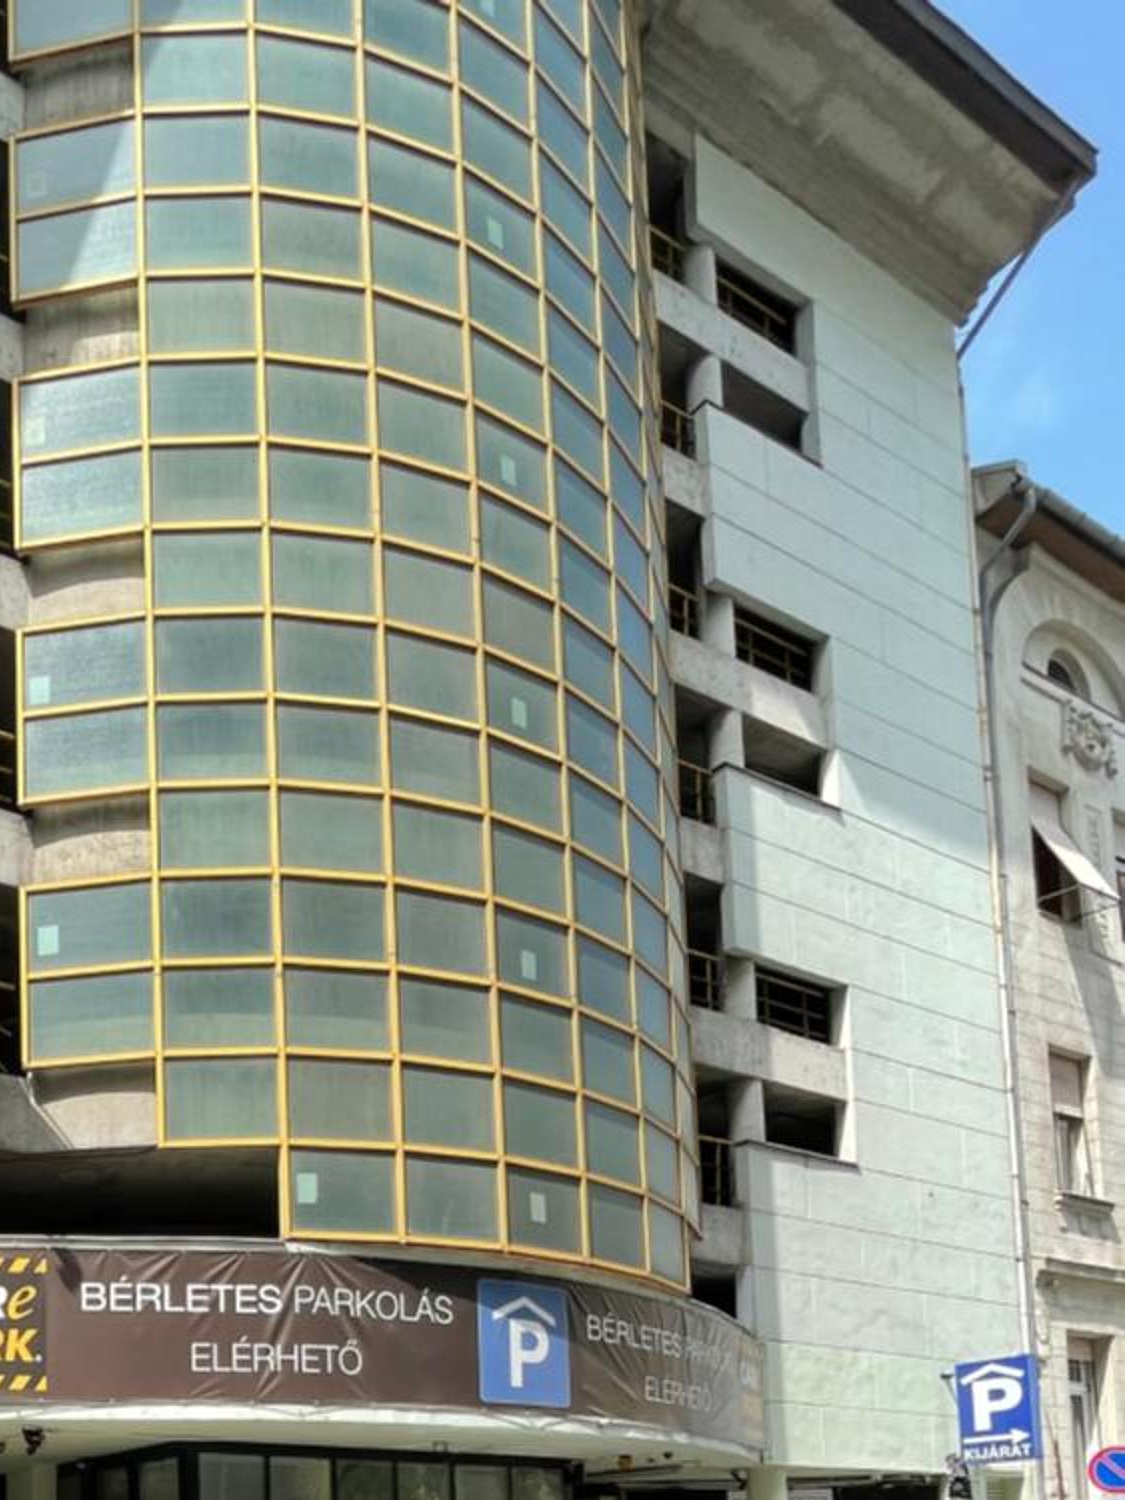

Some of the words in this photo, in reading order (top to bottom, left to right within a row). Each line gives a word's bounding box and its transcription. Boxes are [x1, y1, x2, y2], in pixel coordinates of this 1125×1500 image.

[80, 1275, 283, 1314] BÉRLETES
[294, 1286, 454, 1326] PARKOLÁS
[191, 1336, 363, 1376] ELÉRHETŐ
[508, 1318, 551, 1388] P
[587, 1312, 682, 1358] BÉRLETES
[971, 1377, 1023, 1432] P
